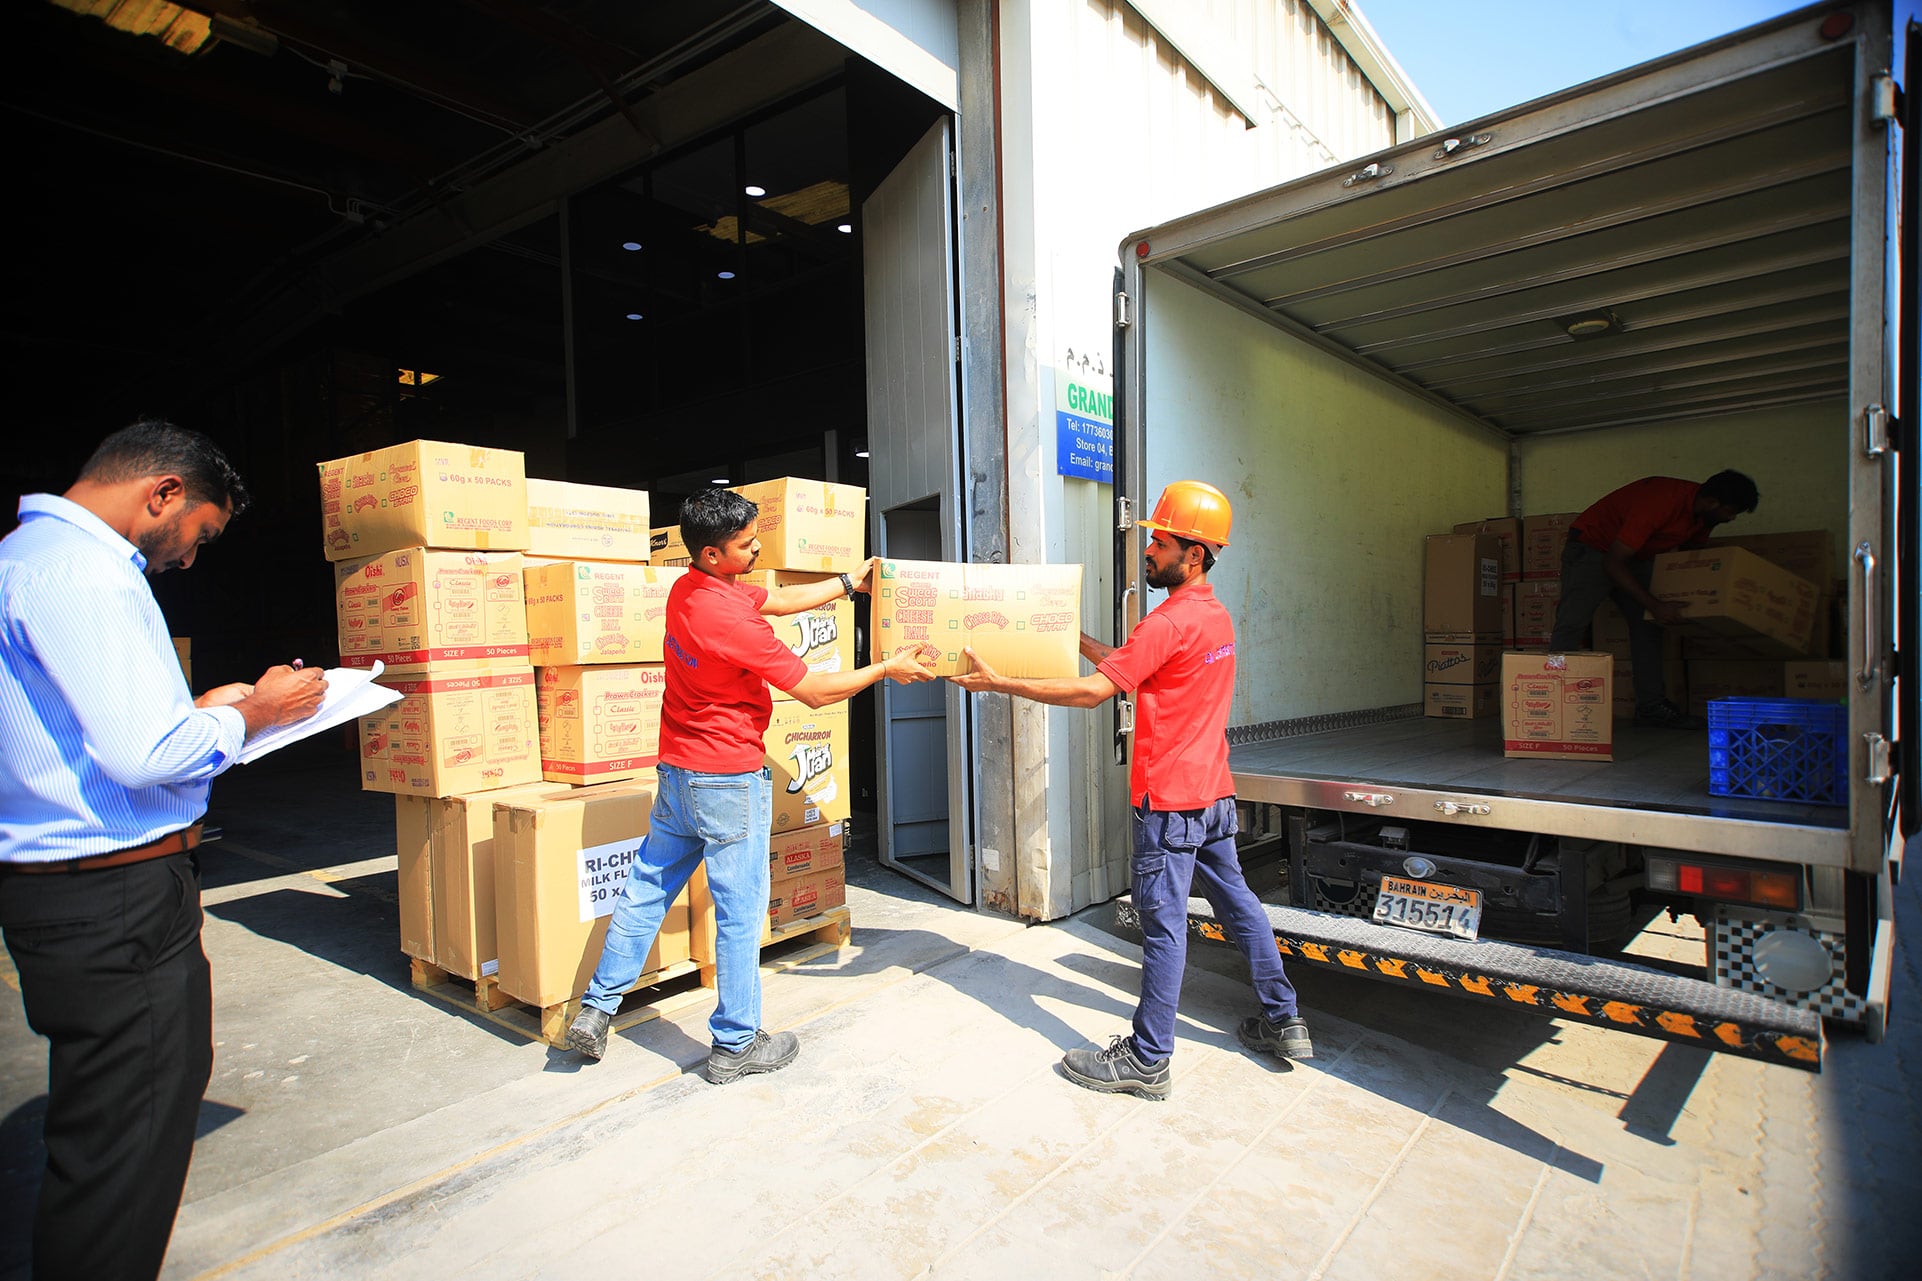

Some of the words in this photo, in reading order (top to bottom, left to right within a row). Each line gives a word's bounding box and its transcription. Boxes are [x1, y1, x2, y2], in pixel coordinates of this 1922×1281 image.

[1066, 418, 1080, 432] Tel:
[1076, 437, 1096, 453] Store
[1096, 442, 1108, 457] 04,
[1070, 452, 1094, 468] Email:
[450, 474, 466, 485] 60g
[474, 476, 484, 485] 50
[485, 478, 512, 488] PACKS
[825, 508, 833, 516] 50
[834, 508, 855, 519] PACKS
[365, 564, 384, 579] Oishi
[594, 573, 625, 581] REGENT
[900, 570, 940, 580] REGENT
[895, 586, 938, 607] Sweet
[594, 605, 624, 618] CHEESE
[896, 609, 934, 625] CHEESE
[600, 619, 621, 631] BALL
[1030, 612, 1074, 626] CHOCO
[904, 626, 930, 640] BALL
[1036, 623, 1068, 633] STAR
[443, 649, 459, 657] SIZE
[496, 647, 517, 655] Pieces
[351, 657, 362, 665] SIZE
[361, 656, 366, 664] F
[388, 655, 396, 664] 50
[396, 654, 412, 663] Pieces
[1427, 653, 1471, 672] Piattos
[471, 679, 480, 687] 50
[610, 704, 635, 713] Classic
[785, 730, 832, 745] CHICHARRON
[1518, 742, 1534, 750] SIZE
[1535, 742, 1540, 750] F
[1562, 743, 1574, 752] 50
[1574, 744, 1598, 752] Pieces
[609, 760, 626, 771] SIZE
[626, 759, 633, 768] F
[786, 744, 833, 795] Juan
[786, 852, 811, 864] ALASKA
[581, 873, 611, 889] MILK
[613, 869, 629, 881] FL
[1387, 880, 1427, 897] BAHRAIN
[589, 888, 607, 904] 50
[611, 887, 620, 898] x
[792, 893, 818, 906] ALASKA
[1429, 888, 1471, 904] البحرين
[1376, 894, 1471, 934] 315514
